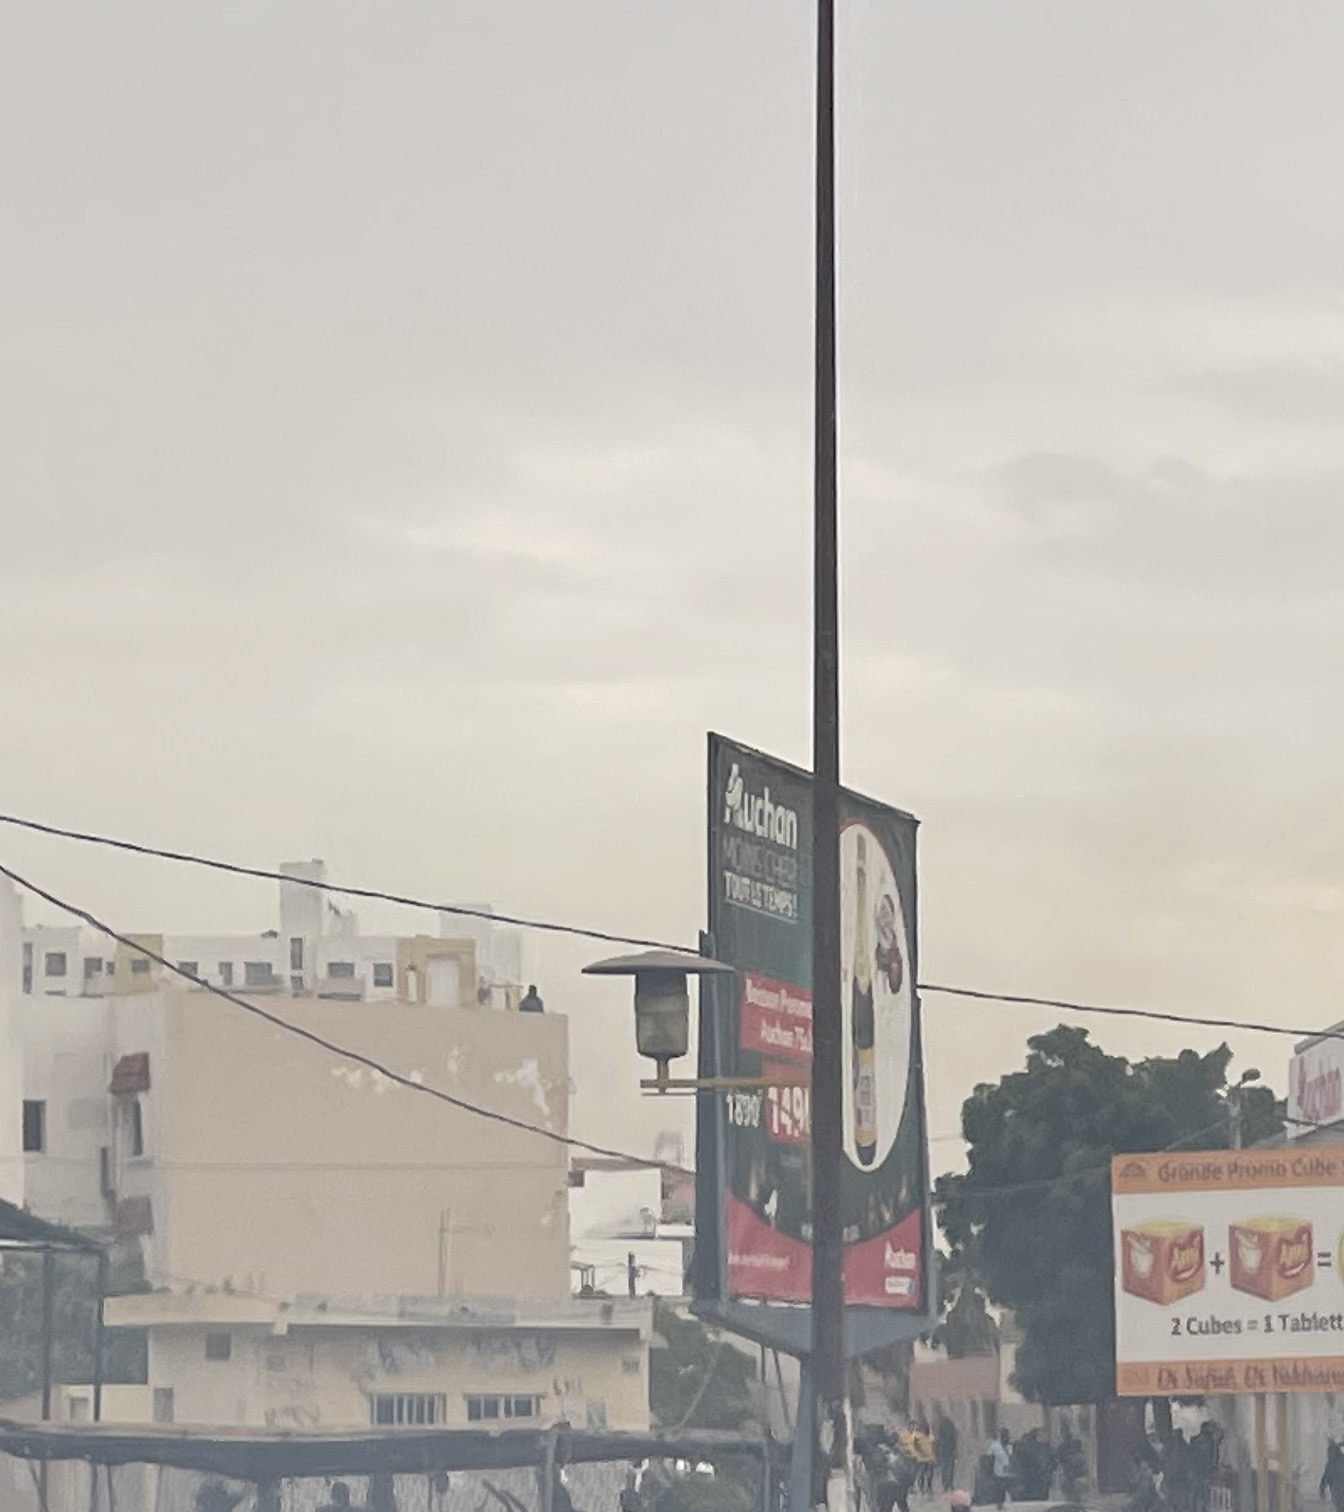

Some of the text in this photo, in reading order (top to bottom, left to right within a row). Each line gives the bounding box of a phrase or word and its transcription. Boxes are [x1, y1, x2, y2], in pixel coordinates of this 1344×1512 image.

[724, 762, 797, 849] Auchan
[1291, 1157, 1336, 1176] Cube
[1171, 1317, 1181, 1335] 2
[1186, 1314, 1242, 1335] Cubes
[1263, 1314, 1274, 1333] 1
